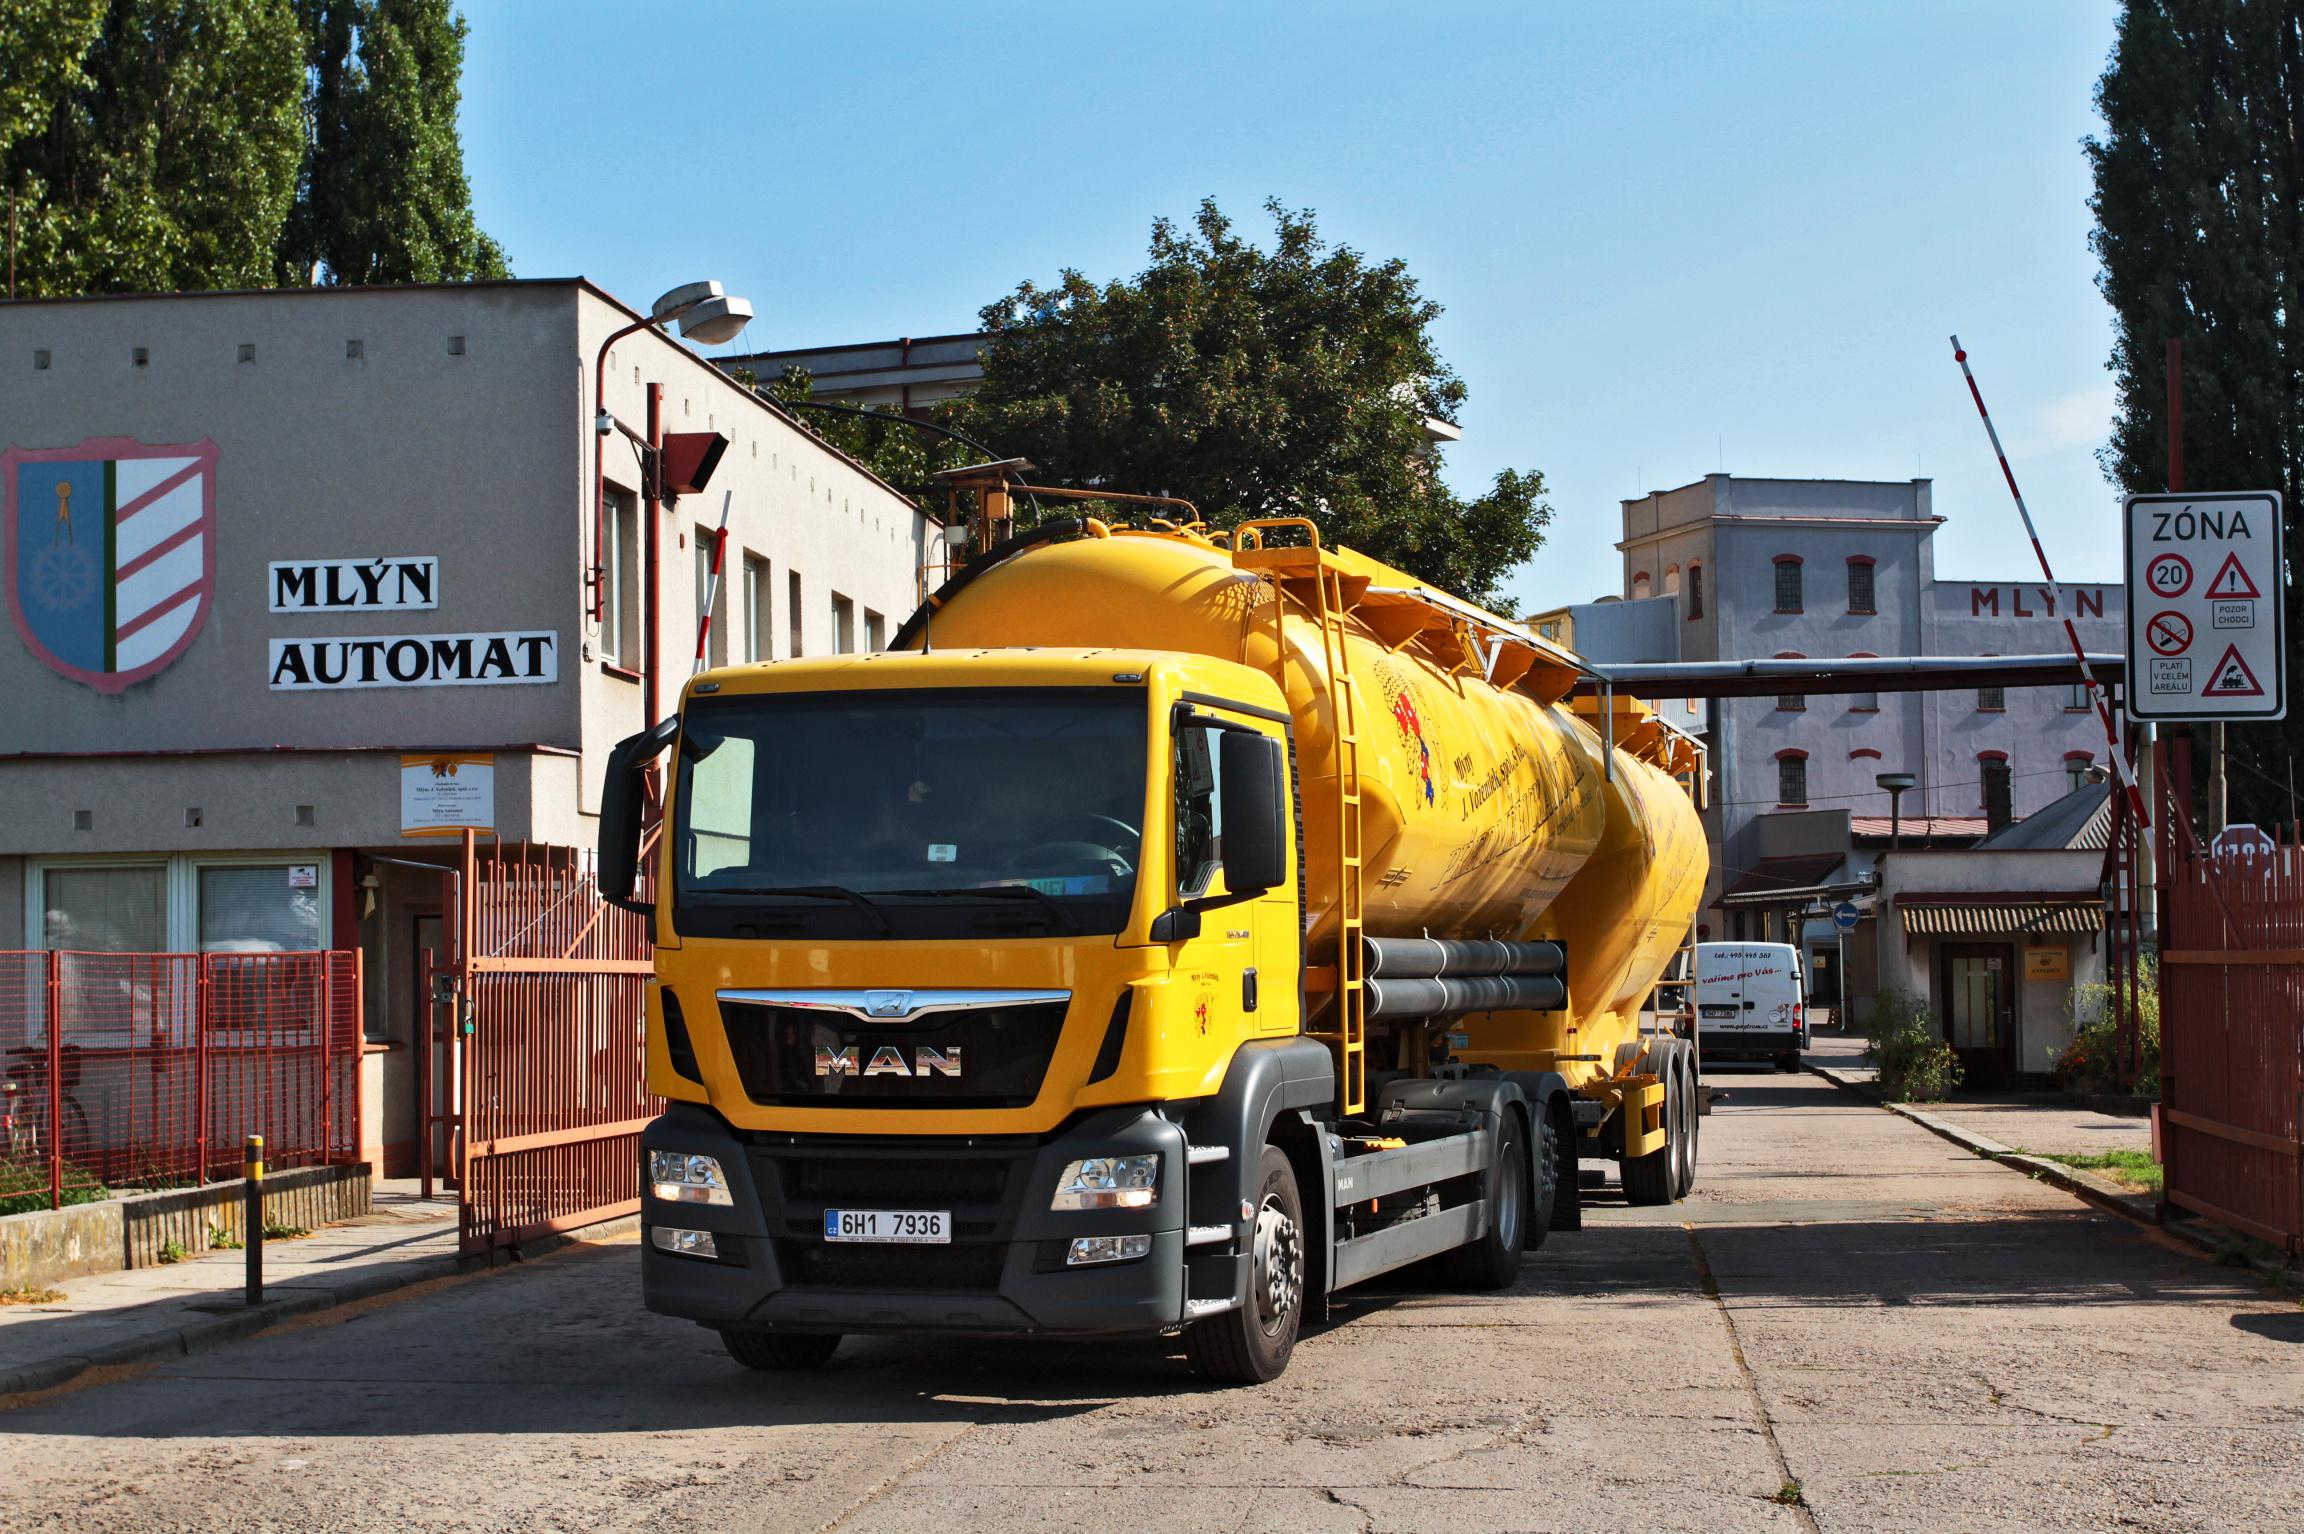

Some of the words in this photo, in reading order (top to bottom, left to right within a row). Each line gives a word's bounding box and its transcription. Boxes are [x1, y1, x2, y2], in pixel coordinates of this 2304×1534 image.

[2152, 505, 2252, 541] ZÓNA
[273, 557, 434, 607] MLÝN
[2157, 566, 2183, 585] 20
[2219, 606, 2247, 615] POZOR
[2218, 615, 2249, 624] CHODCI
[270, 635, 553, 685] AUTOMAT
[2160, 661, 2183, 671] PLATÍ
[2153, 672, 2159, 681] V
[2160, 671, 2189, 681] CELÉM
[2154, 681, 2188, 691] AREÁLU
[1737, 971, 1753, 981] pro
[815, 1046, 962, 1077] MAN
[1337, 1176, 1354, 1191] MAN
[842, 1214, 877, 1235] 6H1
[893, 1214, 941, 1236] 7936
